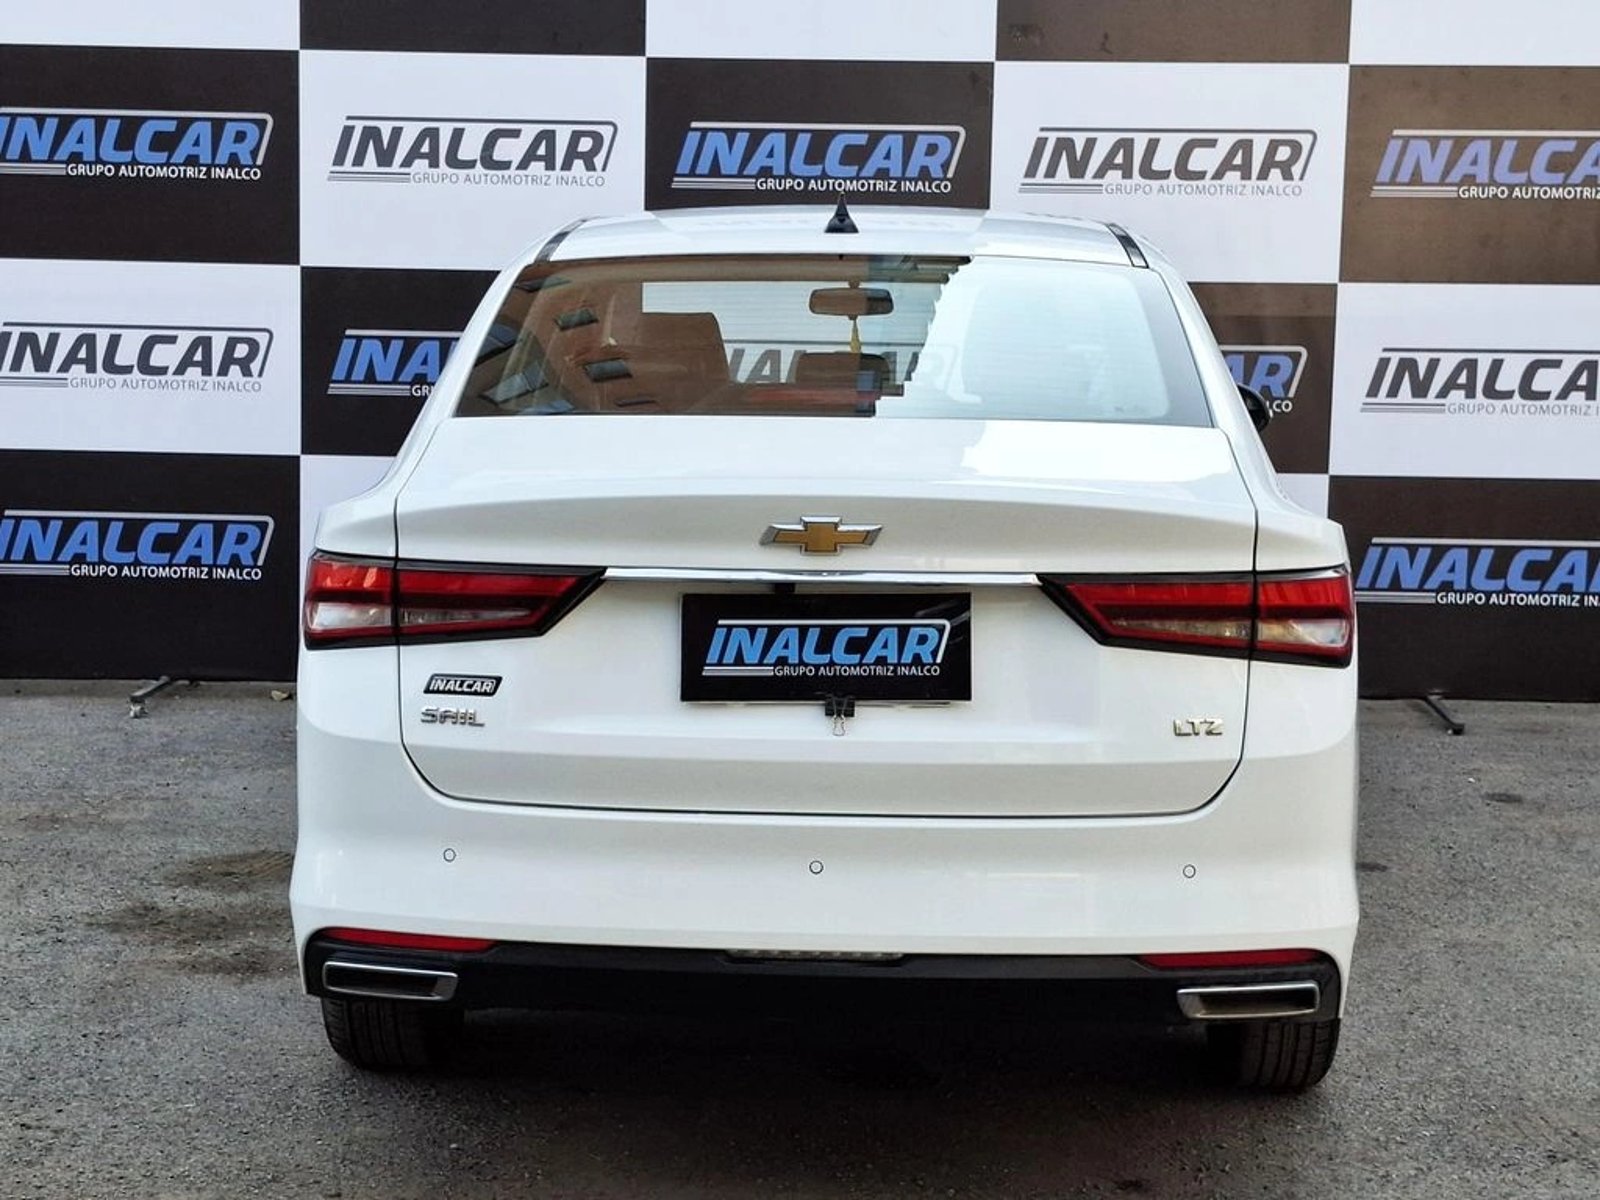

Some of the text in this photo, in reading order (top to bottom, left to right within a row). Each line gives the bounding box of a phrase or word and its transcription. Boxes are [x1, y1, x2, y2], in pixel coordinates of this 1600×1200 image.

[332, 125, 604, 171] INALCAR
[676, 131, 952, 177] INALCAR
[1023, 136, 1303, 181] INALCAR
[67, 163, 261, 181] GRUPO AUTOMOTRIZ INALCO
[412, 172, 606, 188] GRUPO AUTOMOTRIZ INALCO
[756, 177, 951, 194] GRUPO AUTOMOTRIZ INALCO
[1104, 184, 1303, 197] GRUPO AUTOMOTRIZ INALCO
[1458, 186, 1508, 198] GRUPO
[0, 331, 260, 376] INALCAR
[70, 378, 262, 393] GRUPO AUTOMOTRIZ INALCO
[1448, 402, 1496, 415] GRUPO
[1501, 403, 1591, 416] AUTOMOTRIZ
[0, 519, 262, 564] INALCAR
[71, 564, 262, 580] GRUPO AUTOMOTRIZ INALCO
[1355, 546, 1600, 592] INALCA
[1437, 592, 1486, 605] GRUPO
[1490, 592, 1581, 606] AUTOMOTRIZ
[706, 627, 939, 664] INALCAR
[774, 665, 940, 677] GRUPO AUTOMOTRIZ INALCO
[429, 678, 493, 693] INALCAR
[420, 708, 485, 727] SAIL
[1173, 719, 1223, 736] LTZ
